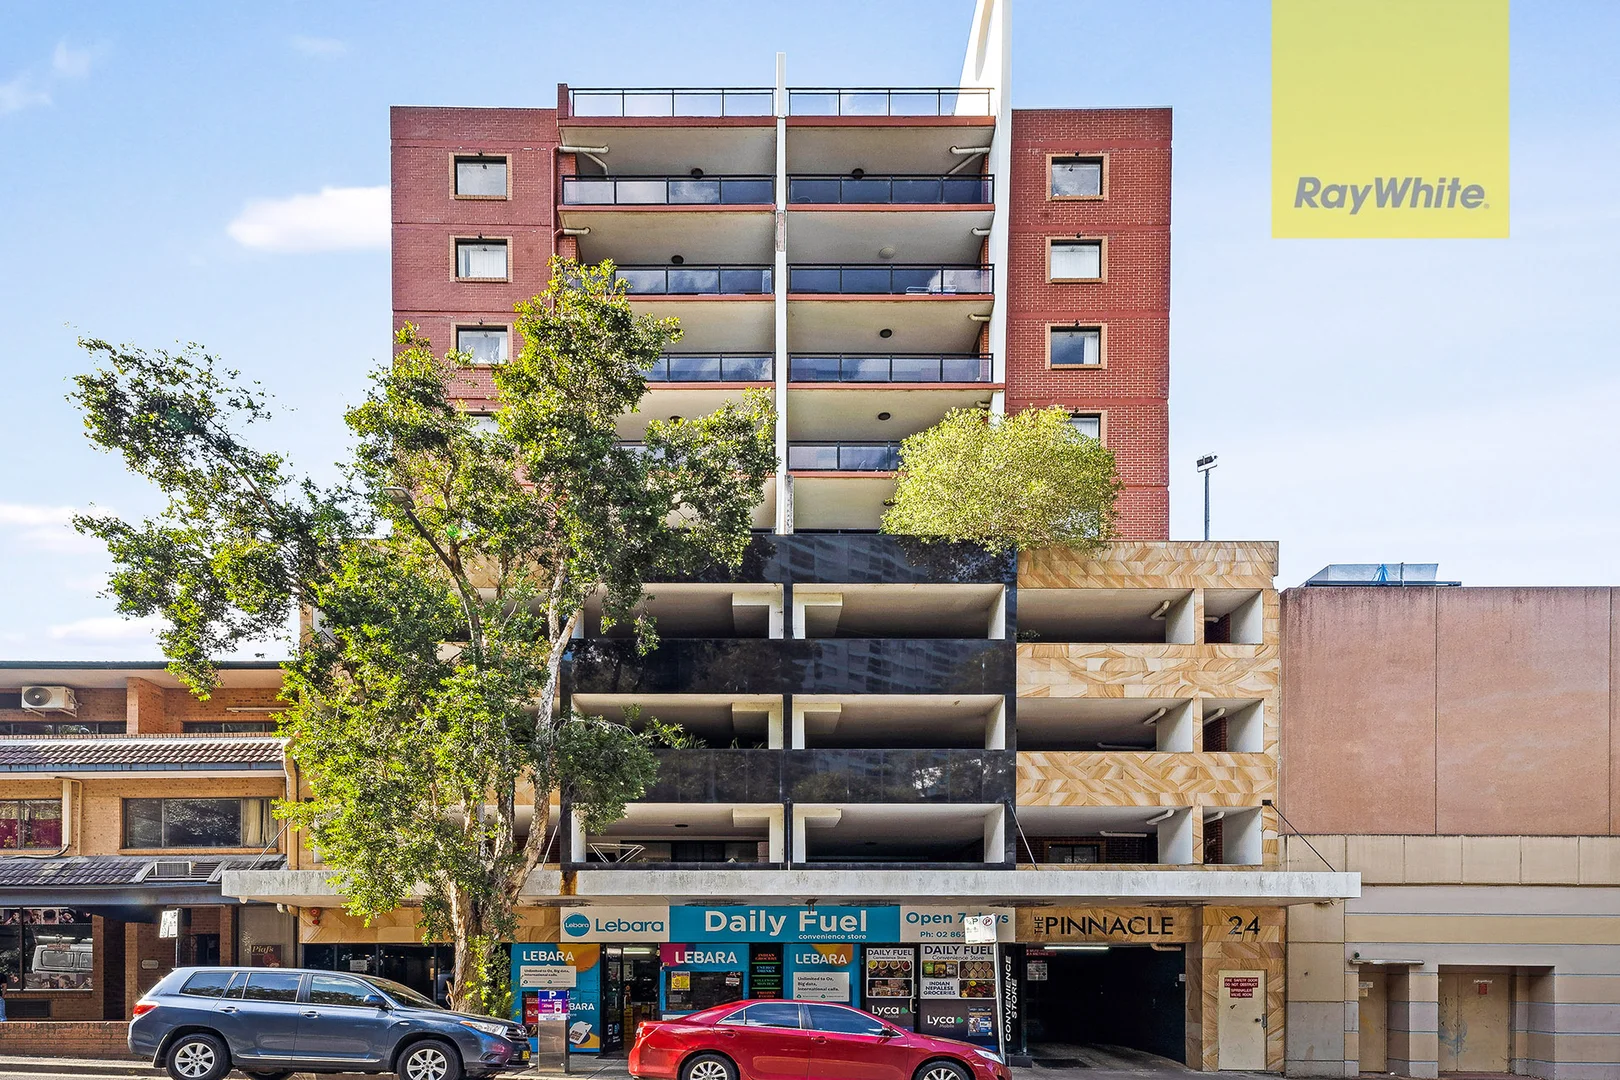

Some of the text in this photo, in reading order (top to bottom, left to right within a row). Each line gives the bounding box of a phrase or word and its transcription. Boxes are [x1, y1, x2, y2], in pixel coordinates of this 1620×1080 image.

[705, 910, 867, 936] Daily Fuel
[905, 911, 953, 925] Open
[957, 912, 966, 923] 7
[595, 918, 664, 932] Lebara
[1034, 916, 1044, 934] THE
[1045, 916, 1174, 935] PINNACLE
[1228, 915, 1261, 935] 24
[924, 945, 993, 955] DAILY FUEL
[523, 951, 575, 962] LEBARA
[675, 951, 738, 964] LEBARA
[795, 953, 848, 965] LEBARA
[549, 991, 557, 999] P
[569, 1002, 595, 1011] BARA
[871, 1005, 899, 1015] Lyca
[927, 1015, 955, 1025] Lyca
